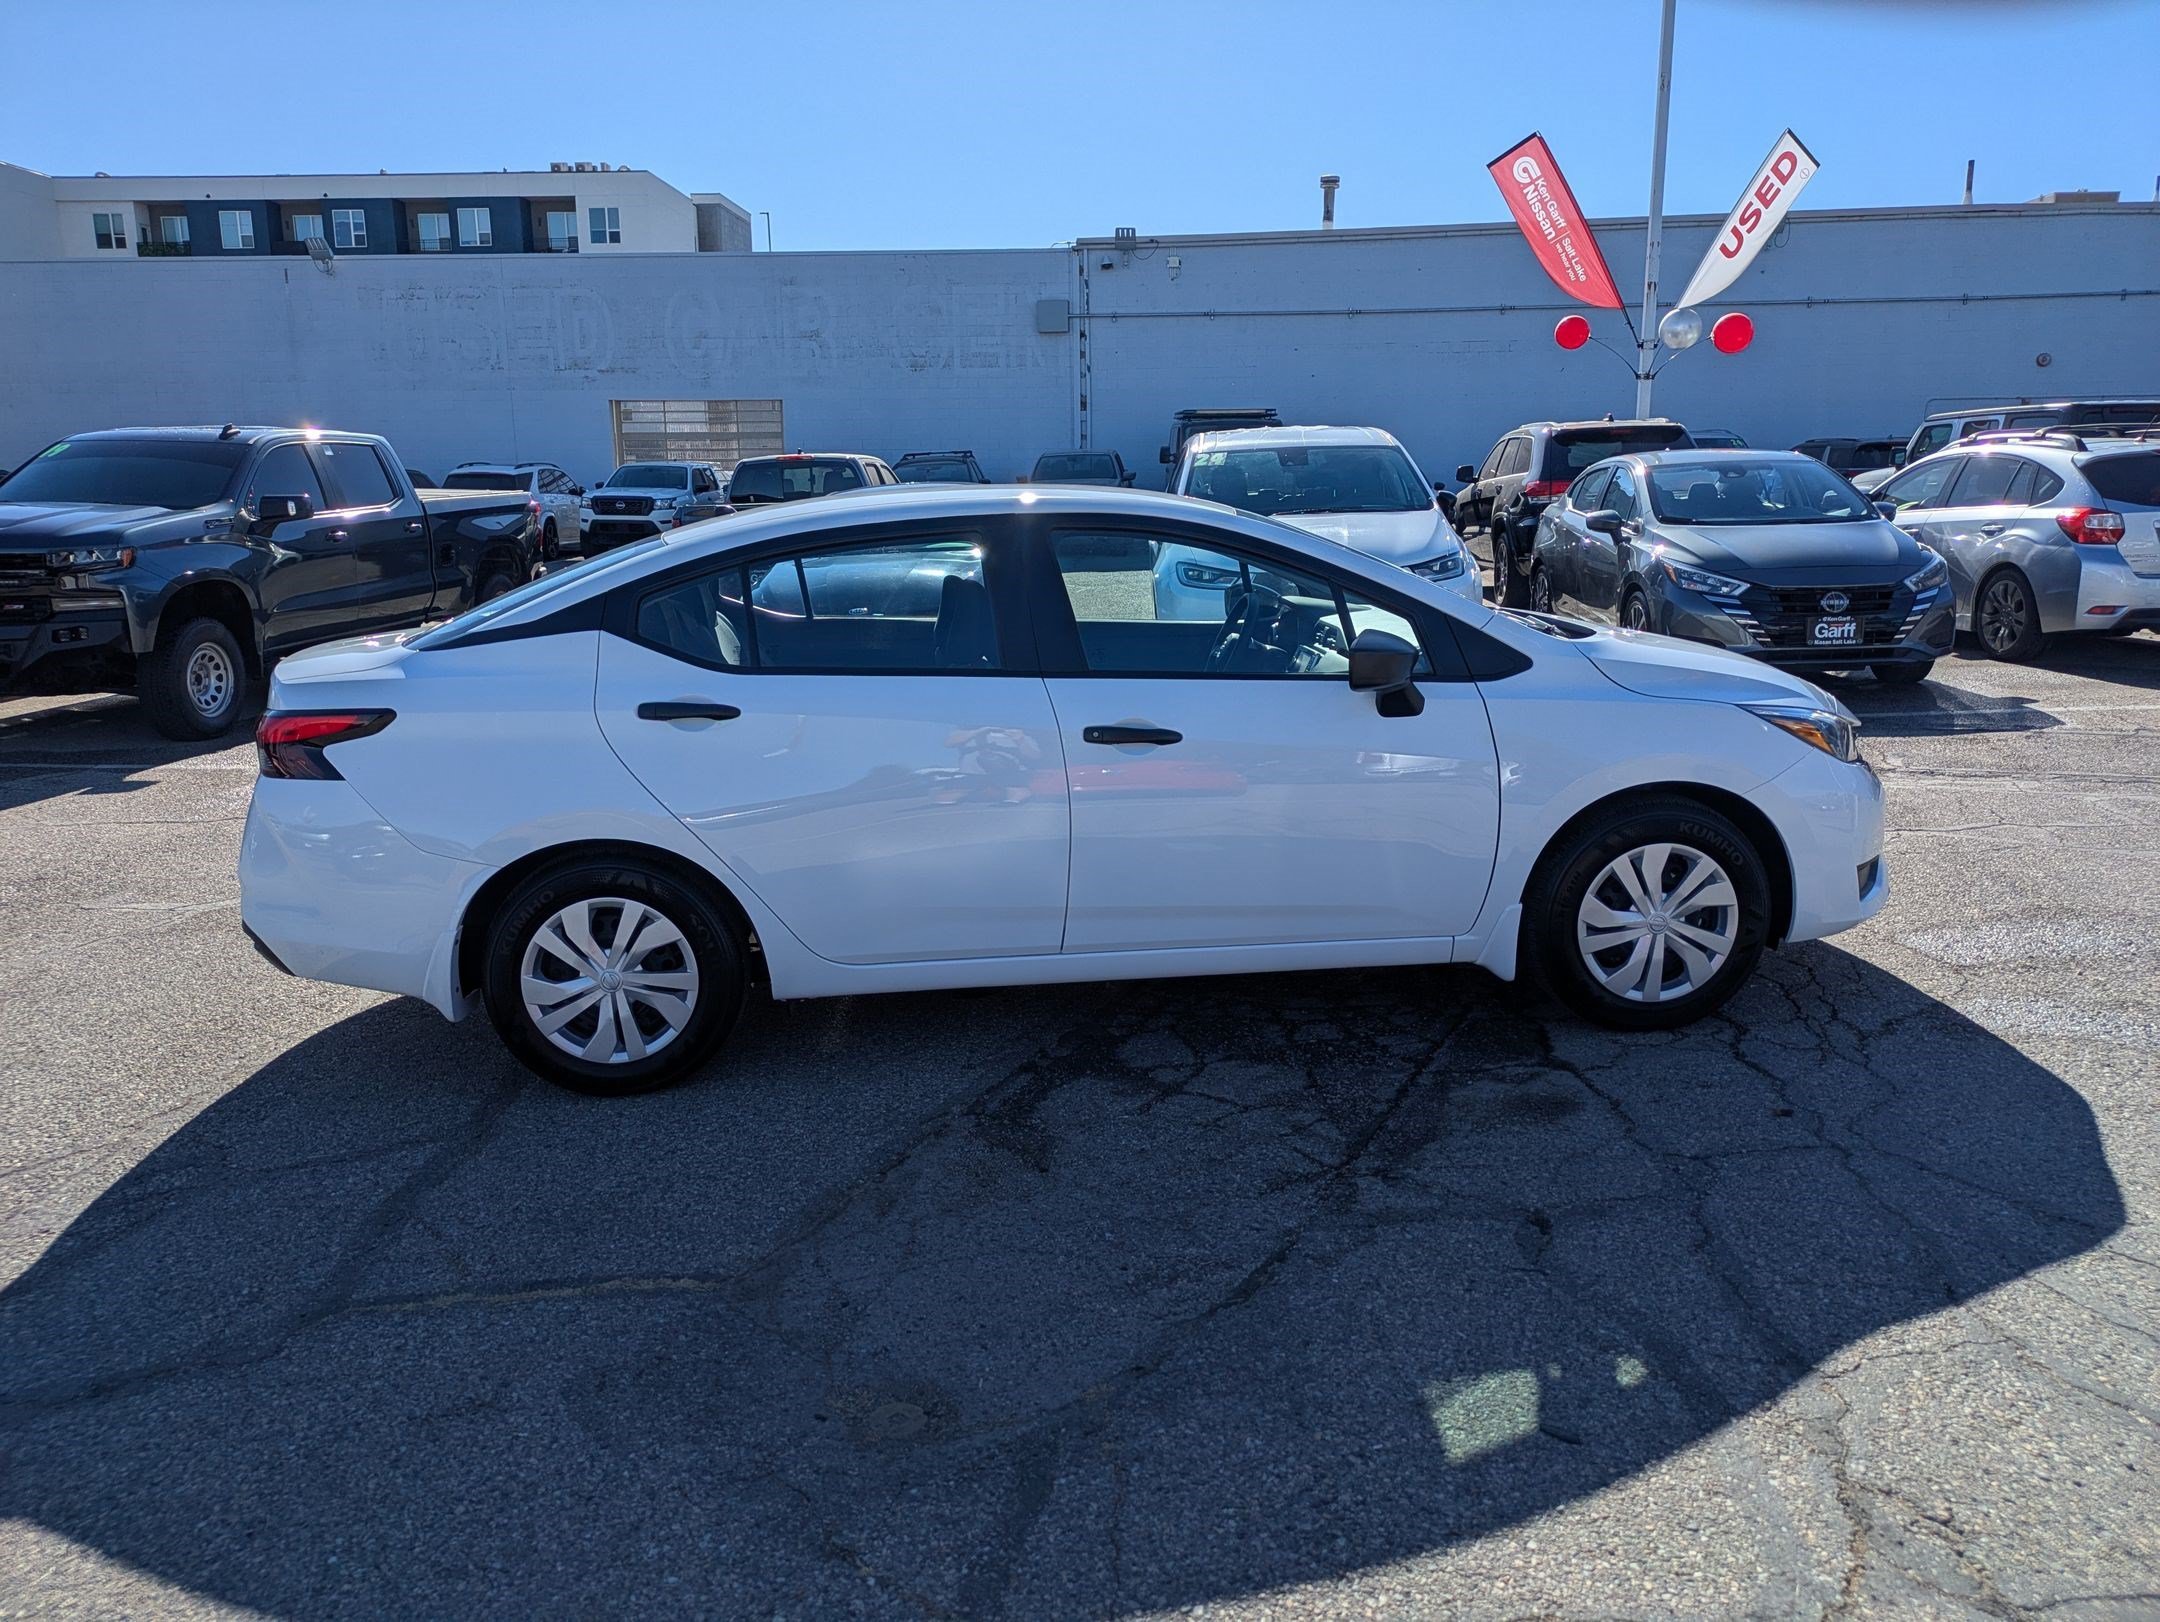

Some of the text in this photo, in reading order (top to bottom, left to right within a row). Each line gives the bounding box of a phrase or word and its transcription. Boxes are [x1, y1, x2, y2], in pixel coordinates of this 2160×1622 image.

[1522, 184, 1557, 241] Nissan
[1534, 177, 1567, 229] Ken Garff
[1718, 150, 1799, 260] USED
[1555, 242, 1577, 282] we hear you
[1562, 237, 1587, 282] Salt Lake
[1814, 622, 1857, 638] Garff
[1679, 821, 1744, 867] KUMHO
[499, 889, 555, 957] KUMHO
